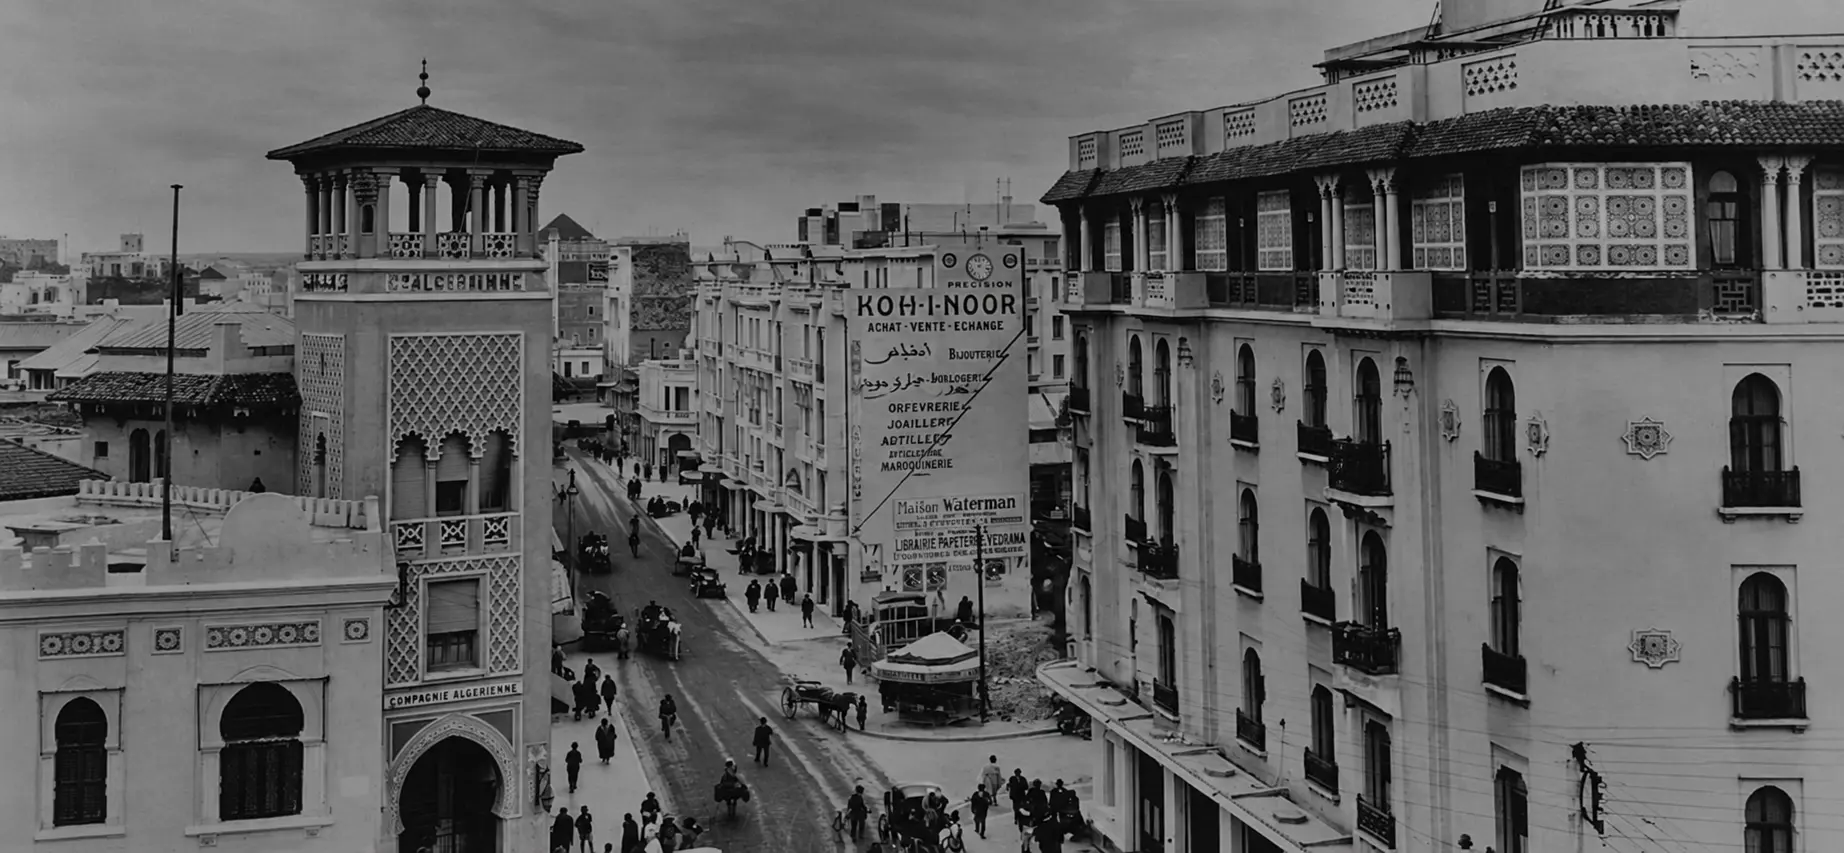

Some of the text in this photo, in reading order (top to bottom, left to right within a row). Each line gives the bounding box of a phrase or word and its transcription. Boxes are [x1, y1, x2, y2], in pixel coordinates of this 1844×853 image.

[857, 294, 1016, 316] KOH-I-NOOR
[868, 320, 1004, 333] ACHAT VENTE ECHANGE
[888, 401, 960, 413] ORFEVRERIE
[881, 459, 953, 472] MAROQUINERIE
[898, 497, 1016, 514] Maison Waterman
[895, 537, 937, 551] LIBRAIRIE
[938, 534, 986, 548] PAPETERE
[389, 683, 518, 707] COMPAGNIE ALGERIENNE
